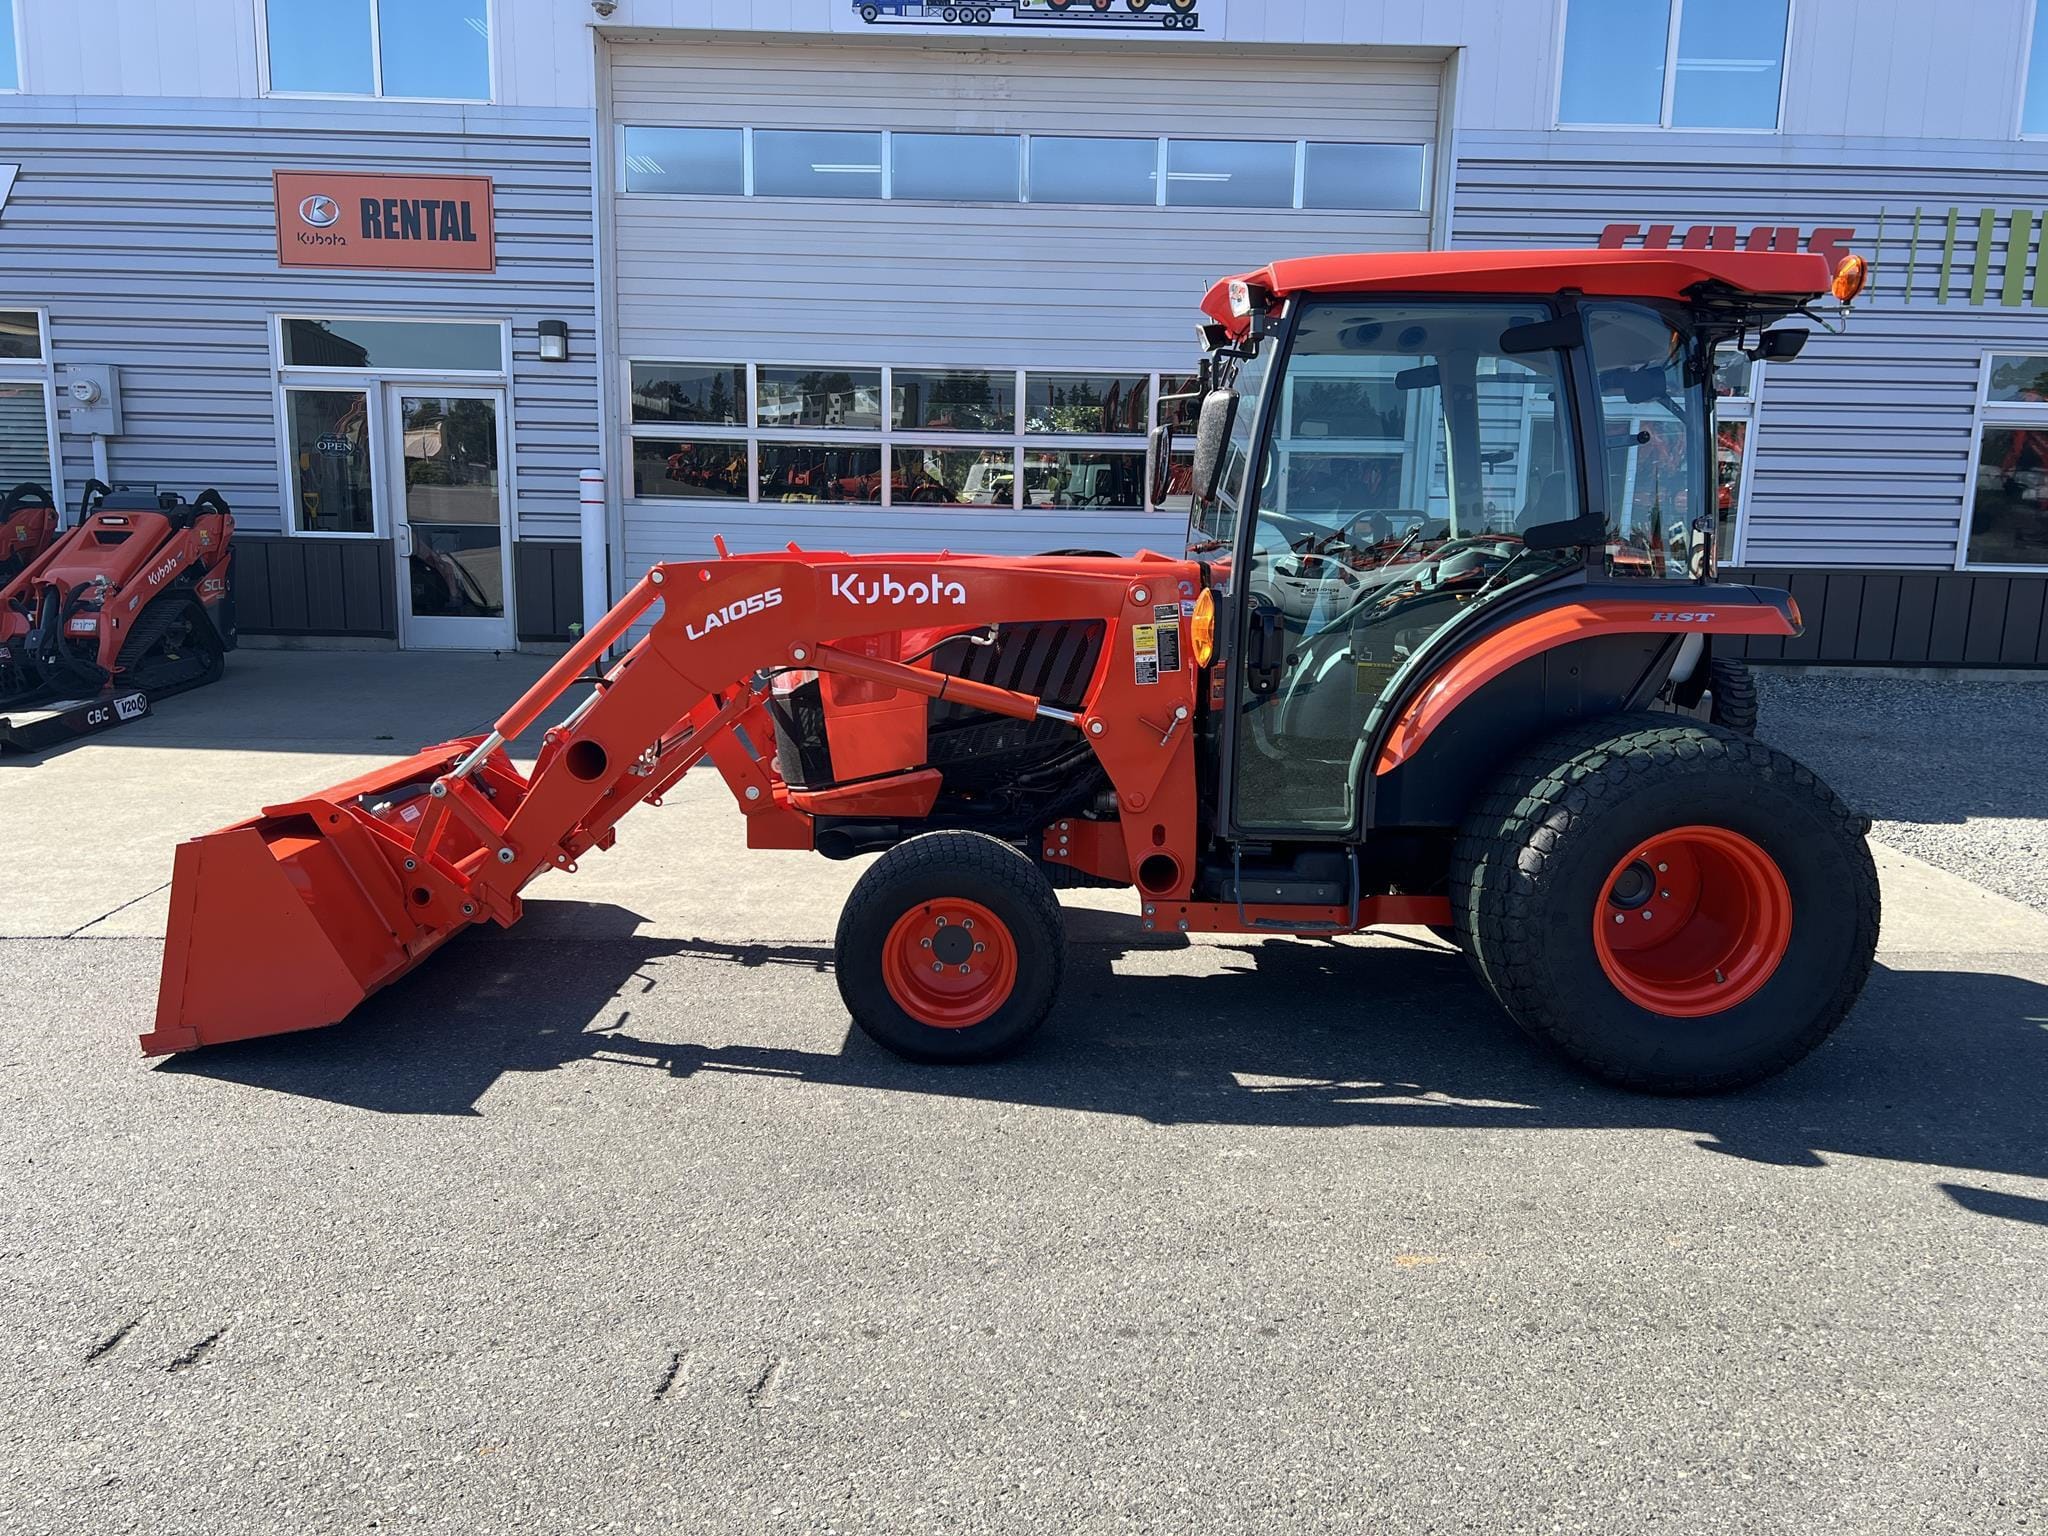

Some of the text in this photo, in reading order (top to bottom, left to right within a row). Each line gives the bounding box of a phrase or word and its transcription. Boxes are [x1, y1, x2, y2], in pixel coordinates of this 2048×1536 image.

[359, 197, 477, 242] RENTAL
[296, 231, 347, 246] Kubota
[316, 441, 352, 451] OPEN
[147, 557, 178, 586] Kubota
[831, 573, 967, 605] Kubota
[684, 586, 784, 641] LA1055
[1651, 612, 1716, 623] HST
[87, 698, 137, 725] CBC V20
